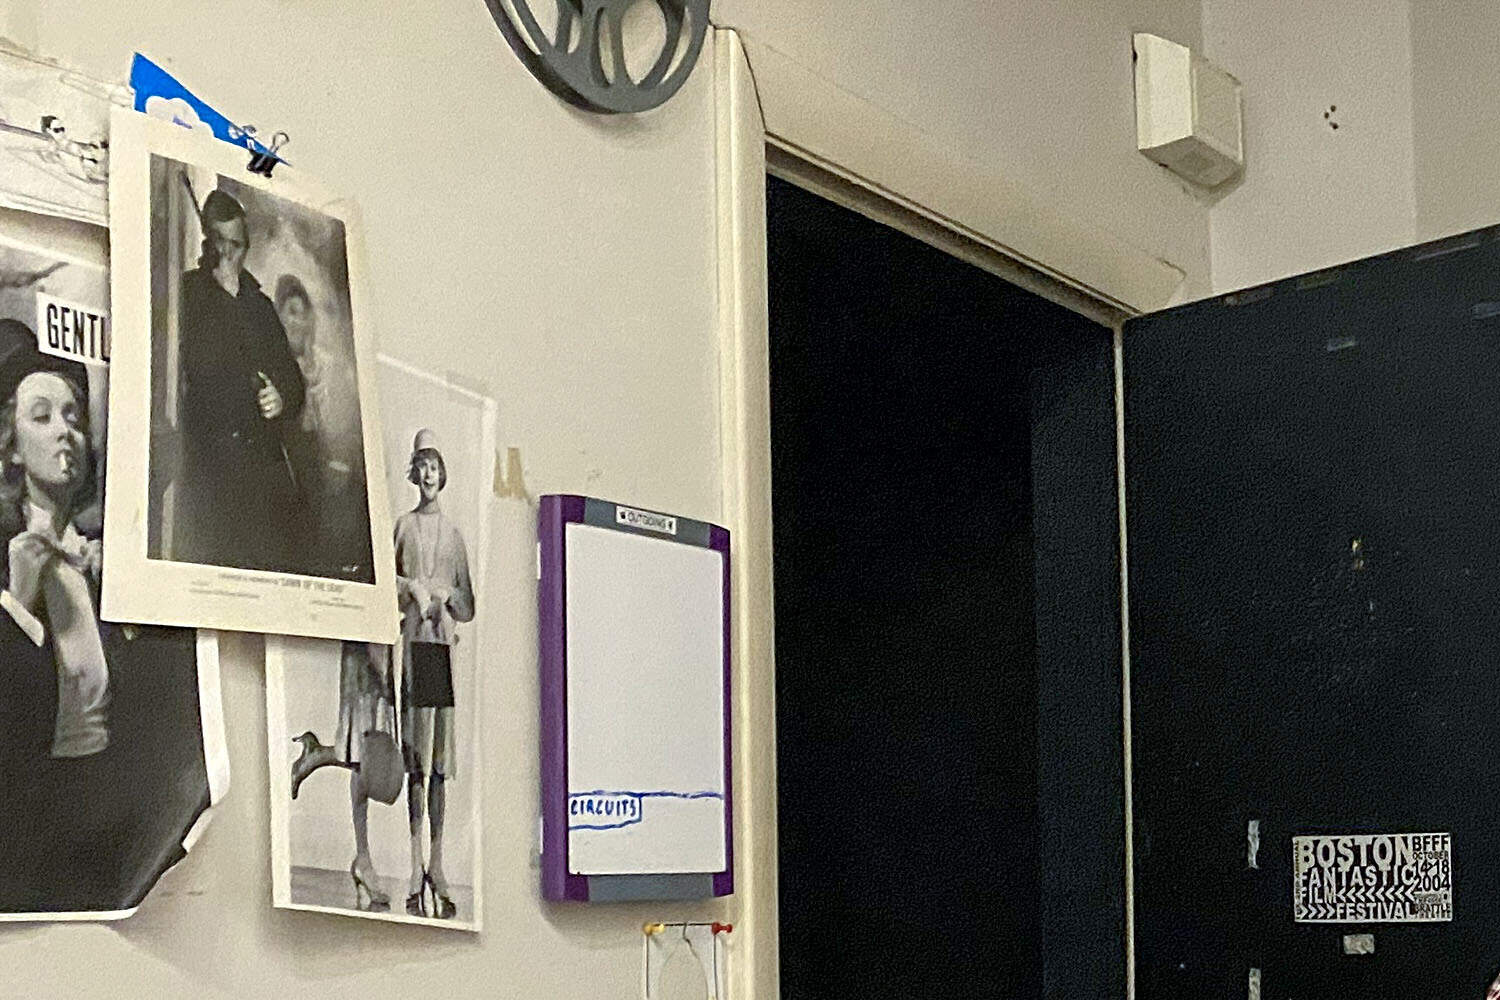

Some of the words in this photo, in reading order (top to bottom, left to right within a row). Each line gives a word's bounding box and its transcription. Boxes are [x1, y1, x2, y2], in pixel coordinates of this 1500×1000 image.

[47, 303, 110, 363] GENTL
[570, 798, 637, 817] CIRCUITS
[1412, 835, 1449, 851] BFFF
[1299, 837, 1415, 872] BOSTON
[1412, 851, 1449, 860] OCTOBER
[1299, 864, 1417, 889] FANTASTIC
[1412, 874, 1451, 892] 2004
[1299, 885, 1337, 904] FILM
[1336, 902, 1416, 920] FESTIVAL
